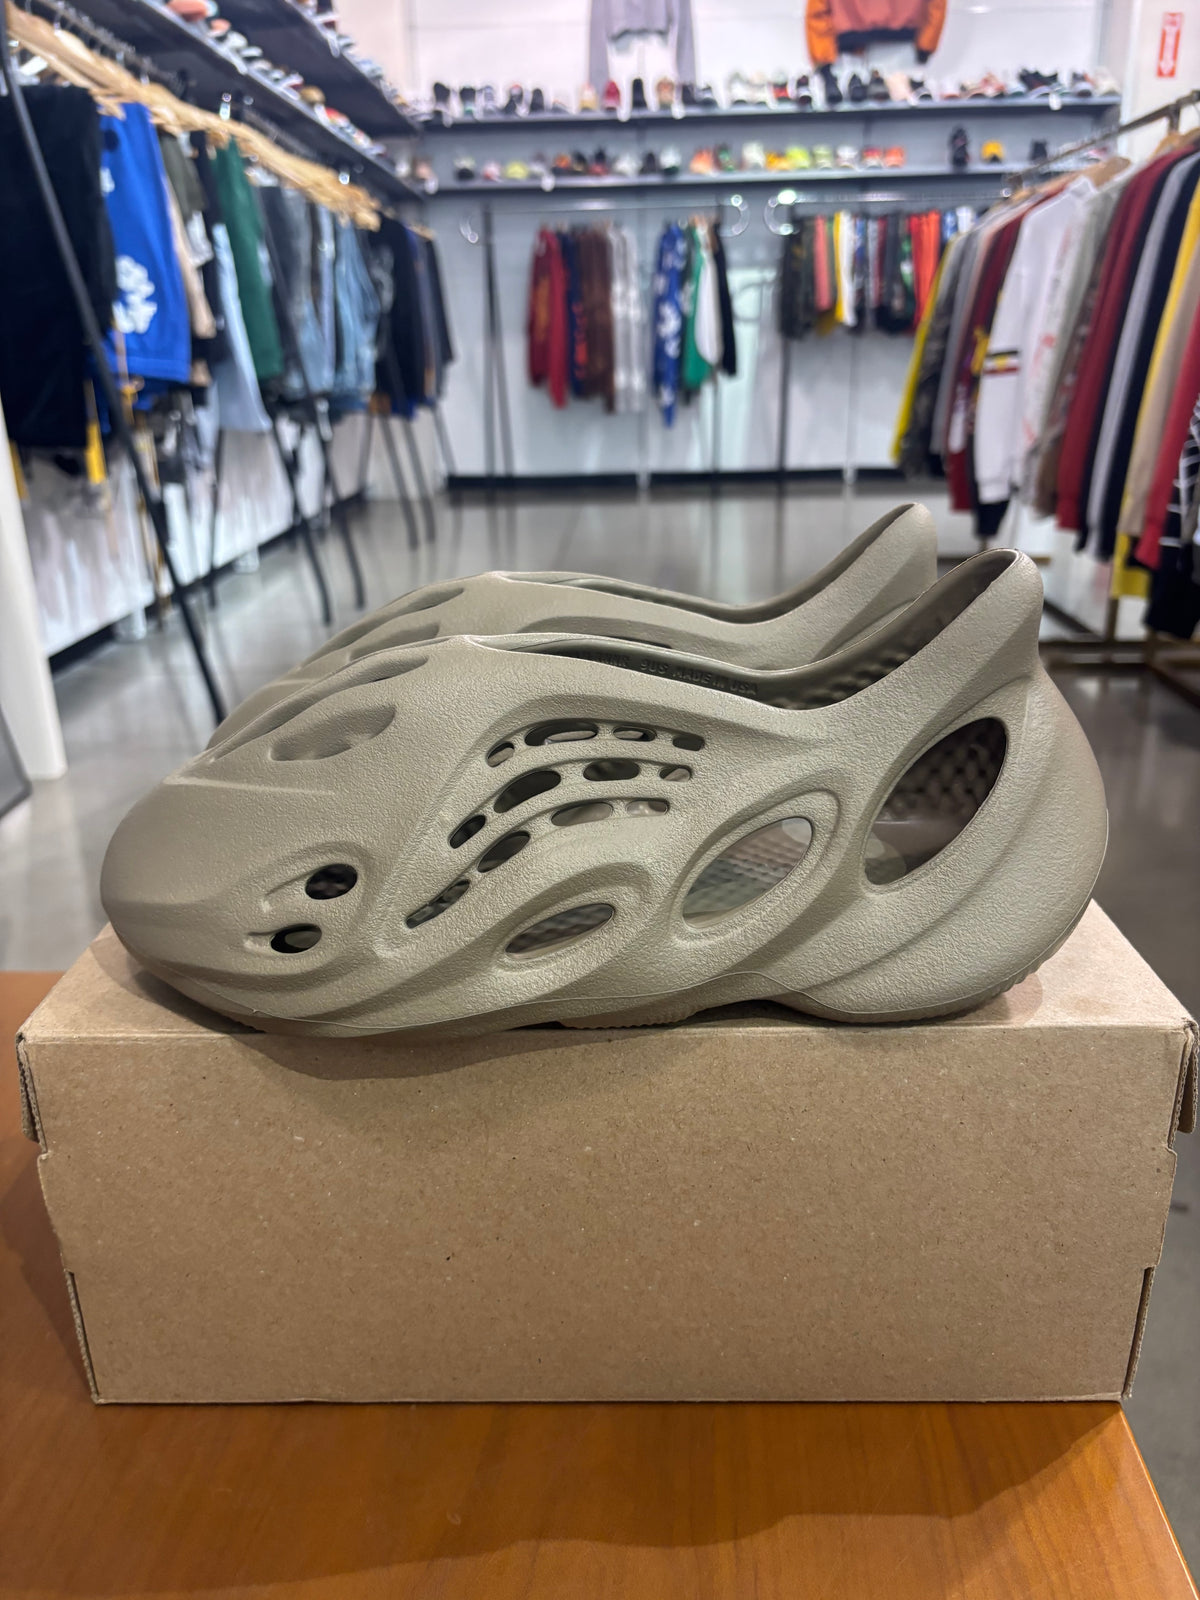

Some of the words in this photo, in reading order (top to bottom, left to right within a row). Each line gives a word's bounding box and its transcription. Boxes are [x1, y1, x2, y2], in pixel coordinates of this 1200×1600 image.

[672, 666, 712, 684] MADE
[712, 675, 728, 689] IN
[729, 679, 758, 695] USA
